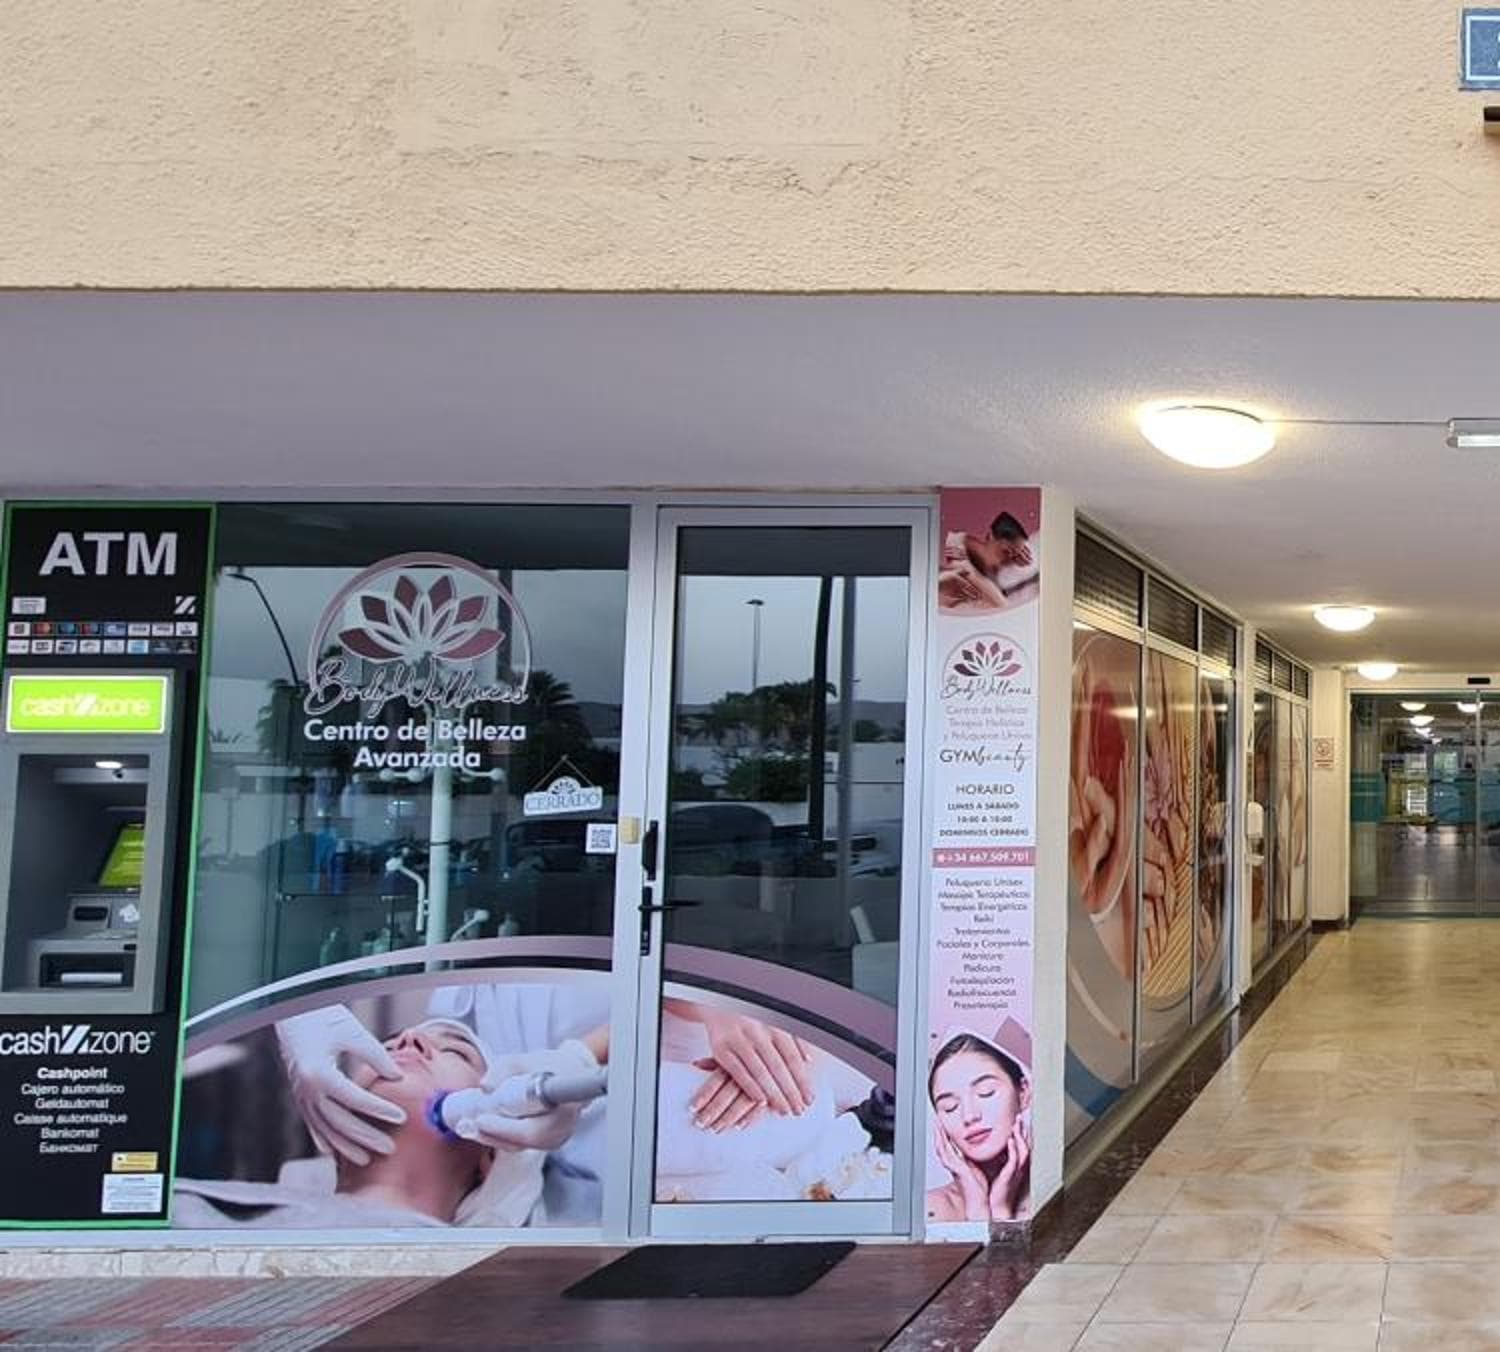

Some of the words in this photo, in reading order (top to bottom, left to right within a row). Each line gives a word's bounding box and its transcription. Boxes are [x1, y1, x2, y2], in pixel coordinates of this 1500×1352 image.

[38, 531, 178, 576] ATM
[303, 719, 390, 741] Centro
[397, 718, 428, 741] de
[438, 718, 527, 741] Belleza
[353, 746, 481, 768] Avanzada
[955, 784, 1015, 795] HORARIO
[37, 1067, 108, 1081] Cashpoint
[21, 1083, 59, 1096] Cajero
[35, 1097, 109, 1109] Geldautomat
[14, 1113, 54, 1125] Caisse
[56, 1112, 128, 1126] automatique
[41, 1127, 100, 1139] Bankomat
